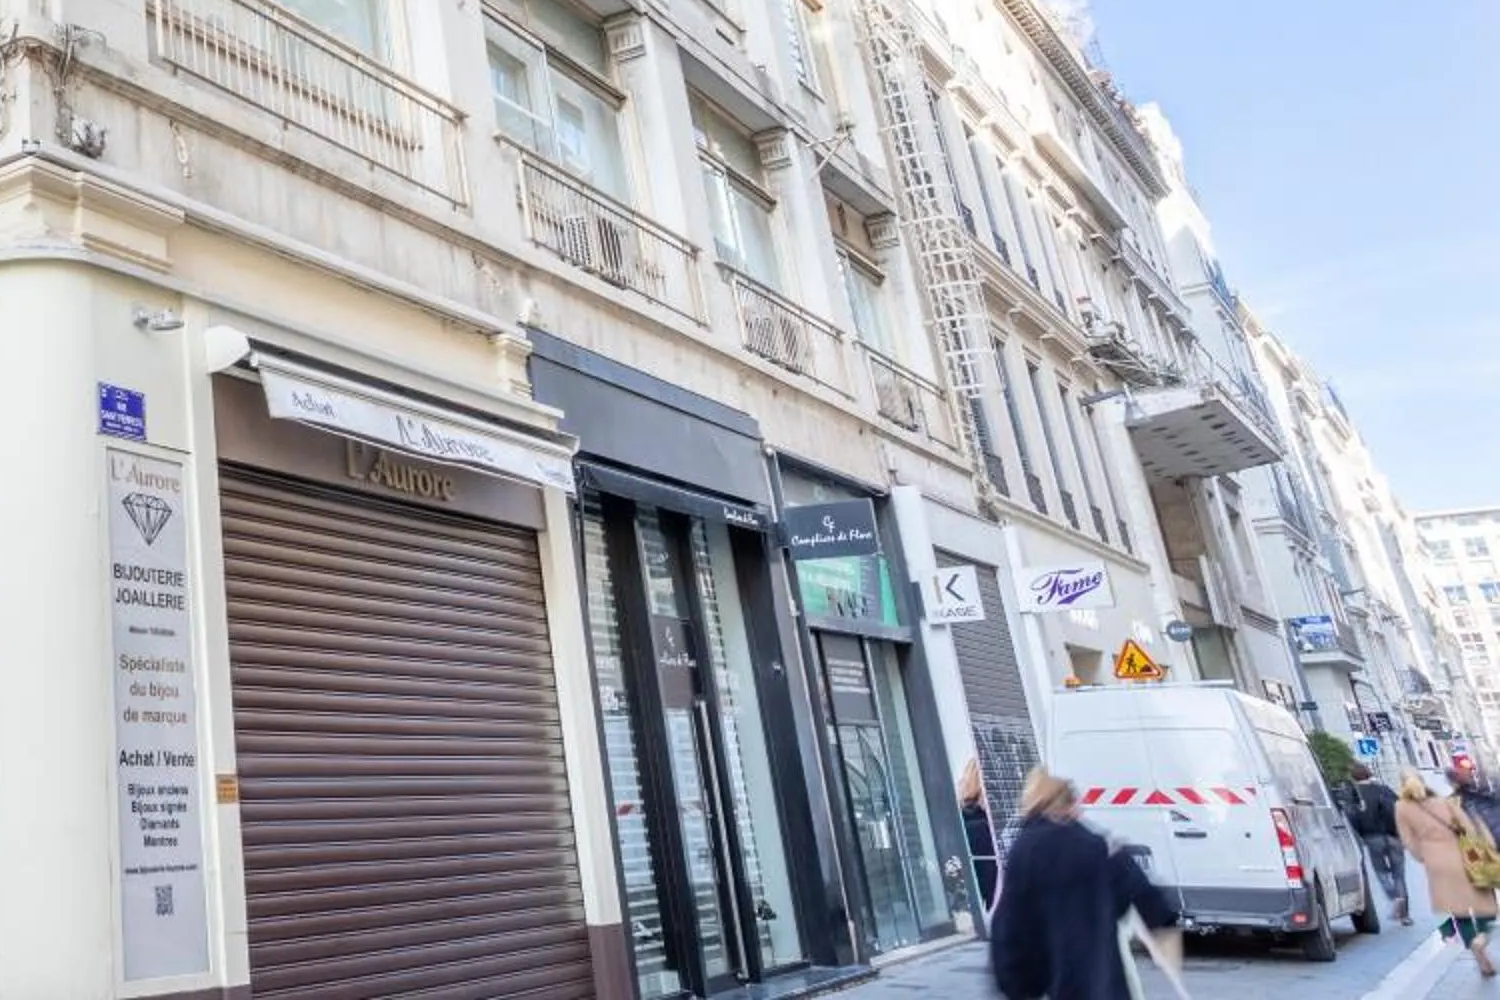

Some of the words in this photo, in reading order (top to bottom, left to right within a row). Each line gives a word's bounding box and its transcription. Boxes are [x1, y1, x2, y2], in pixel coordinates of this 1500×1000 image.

[110, 454, 182, 494] L'Aurore
[113, 562, 185, 588] BIJOUTERIE
[115, 586, 185, 611] JOAILLERIE
[119, 653, 186, 675] Spécialiste
[129, 681, 147, 697] du
[149, 680, 179, 701] bijou
[123, 706, 139, 723] de
[140, 710, 188, 727] marque
[119, 749, 154, 768] Achat
[163, 751, 196, 768] Vente
[131, 801, 158, 816] Bijoux
[140, 818, 180, 831] Diamants
[143, 835, 179, 848] Montres
